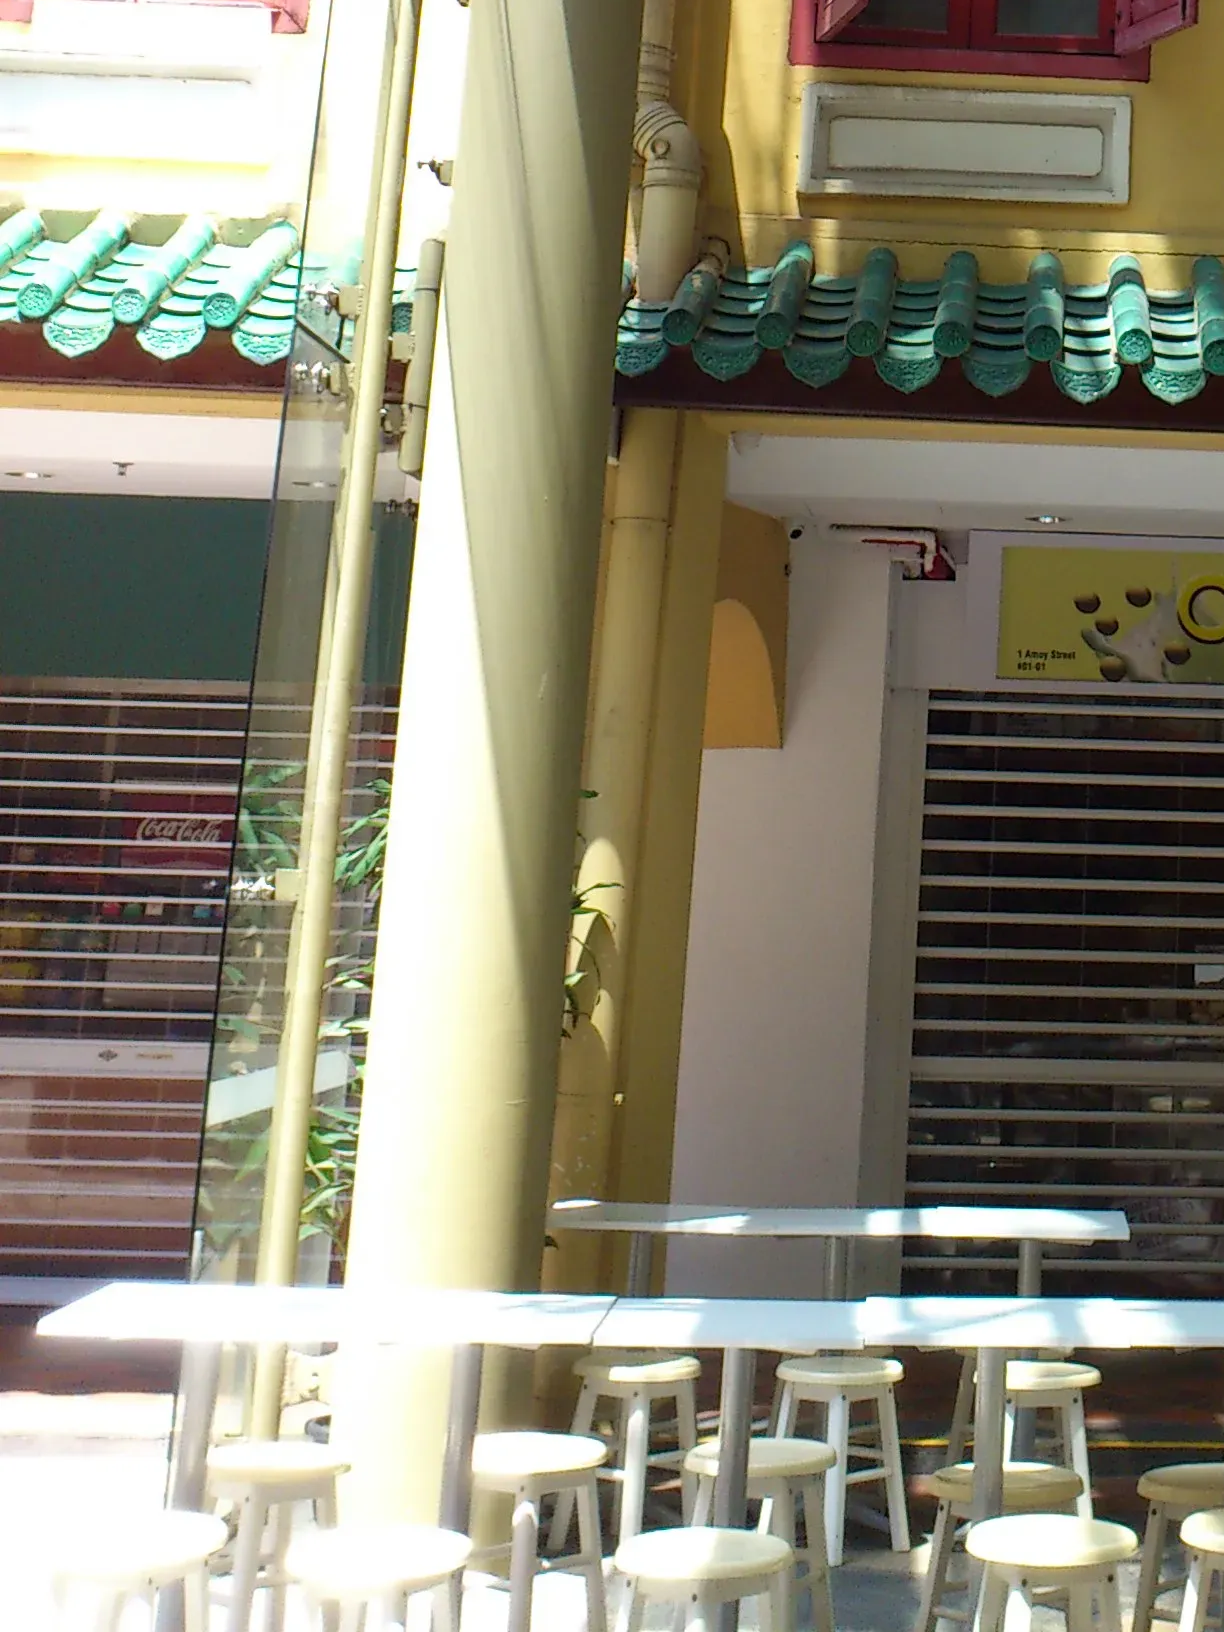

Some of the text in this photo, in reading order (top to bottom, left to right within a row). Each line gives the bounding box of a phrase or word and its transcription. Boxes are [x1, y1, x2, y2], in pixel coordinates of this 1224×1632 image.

[1018, 649, 1076, 660] 1 Amoy Street
